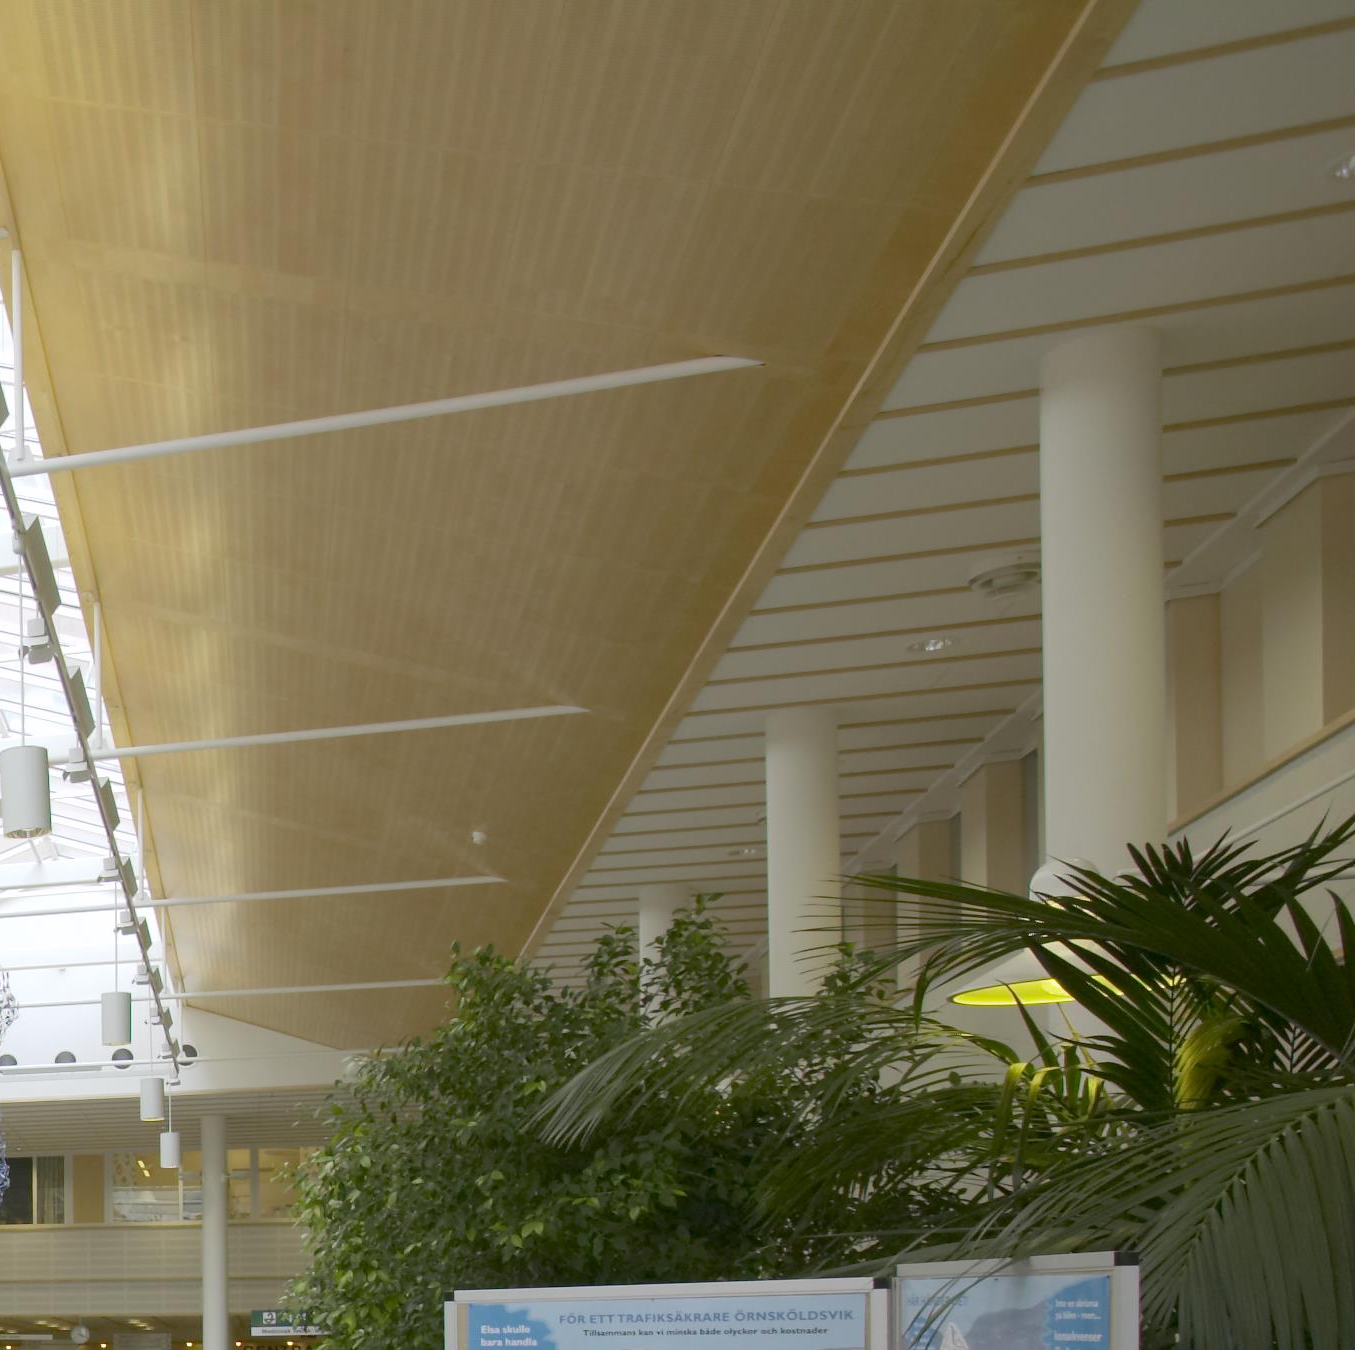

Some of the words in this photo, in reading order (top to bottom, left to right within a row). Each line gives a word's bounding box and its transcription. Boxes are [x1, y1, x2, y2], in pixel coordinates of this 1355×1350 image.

[559, 1313, 586, 1325] FÖR
[589, 1315, 613, 1324] ETT
[617, 1311, 730, 1324] TRAFIKSÄKRARE
[735, 1309, 854, 1322] ÖRNSKÖLDSVIK
[502, 1325, 531, 1334] skulle
[583, 1329, 636, 1337] Tillsammans
[699, 1327, 721, 1336] både
[760, 1327, 778, 1335] och
[780, 1327, 828, 1335] kostnader
[481, 1338, 503, 1346] bara
[505, 1337, 538, 1346] handla
